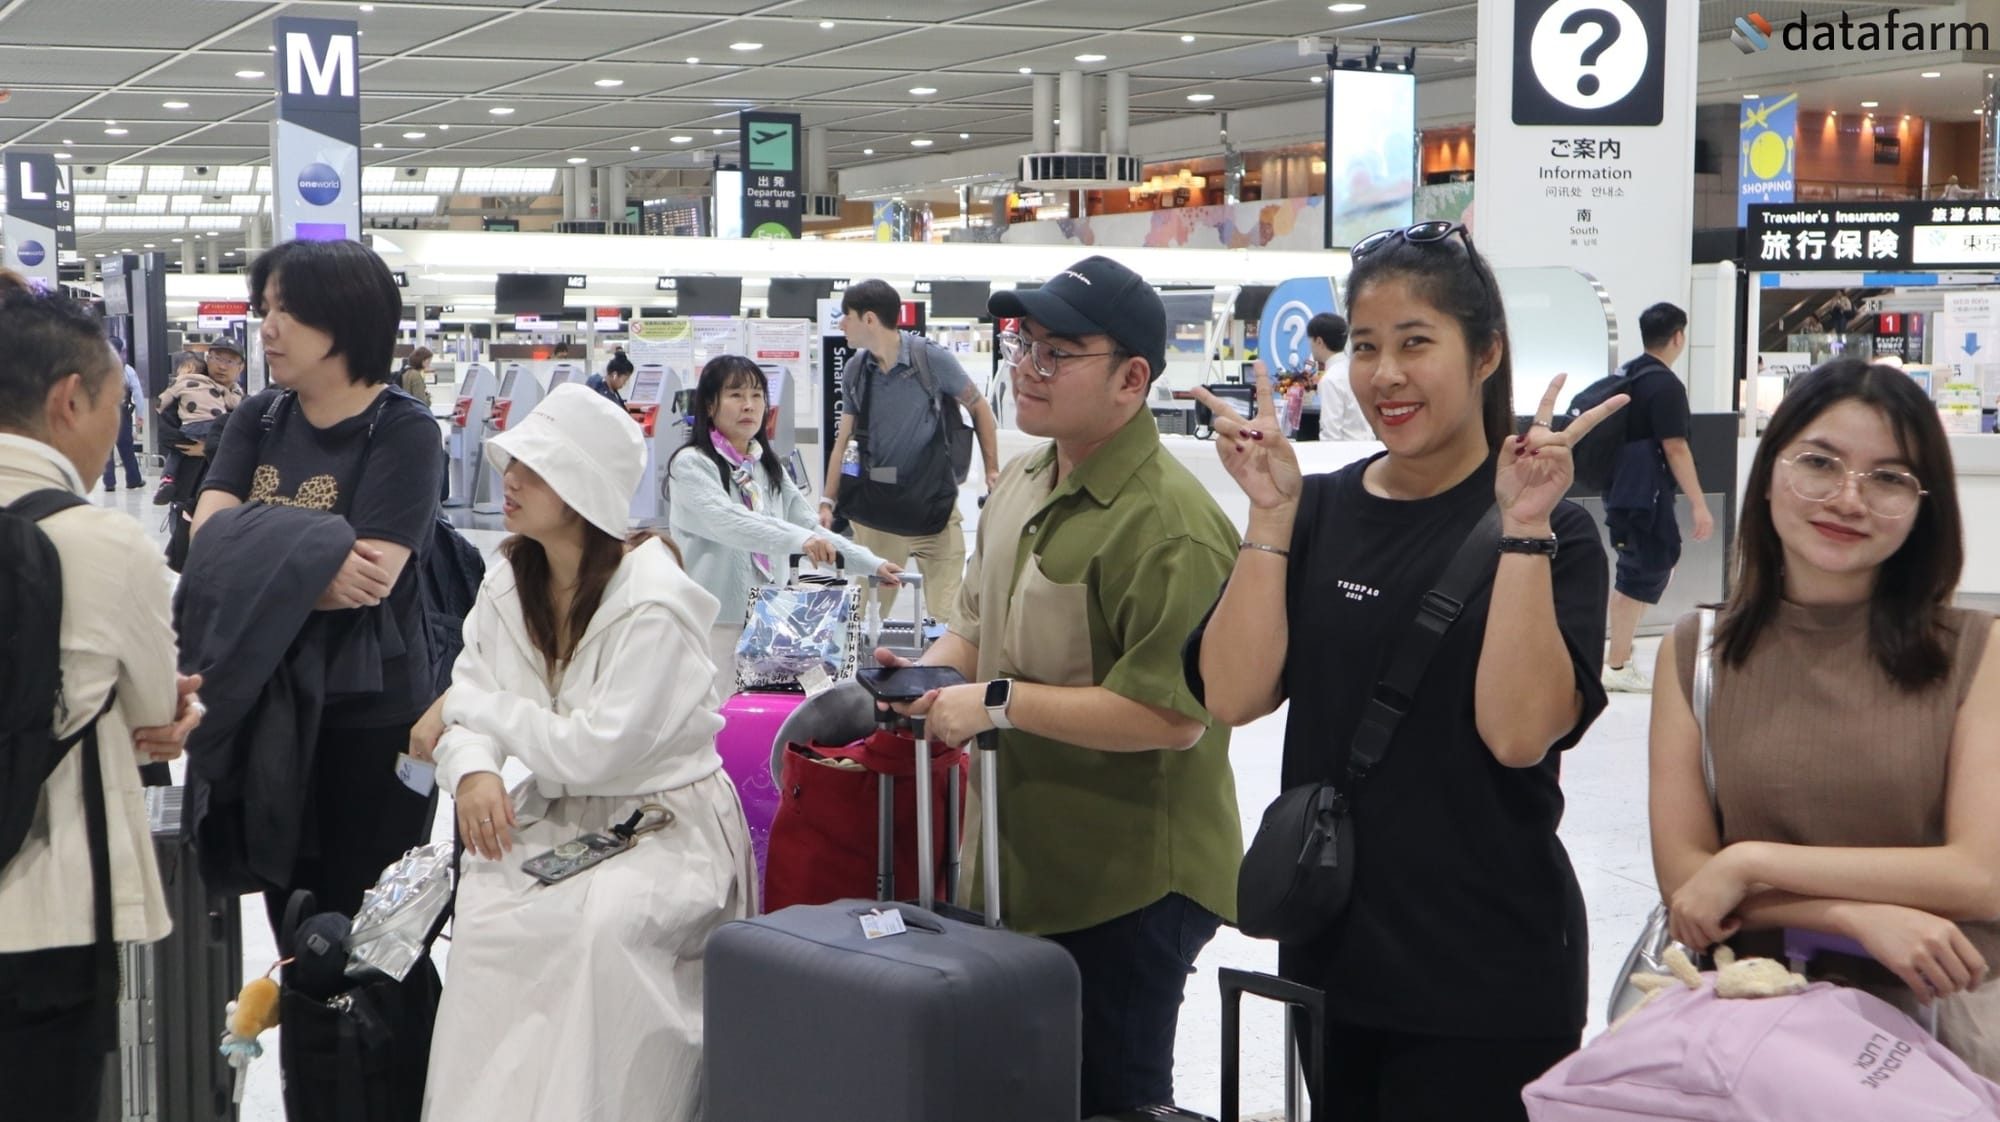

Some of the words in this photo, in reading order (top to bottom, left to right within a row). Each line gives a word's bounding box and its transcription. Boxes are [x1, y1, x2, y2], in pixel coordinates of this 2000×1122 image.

[286, 32, 354, 97] M
[1551, 138, 1621, 159] ご案内
[1539, 165, 1632, 180] Information
[20, 161, 48, 200] L
[299, 180, 340, 189] oneworld
[758, 176, 785, 188] 出発
[1742, 180, 1793, 195] SHOPPING
[747, 187, 796, 198] Departures
[1591, 185, 1625, 198] 안내소
[1576, 208, 1592, 222] 南
[1762, 209, 1829, 224] Traveller's
[1836, 210, 1900, 223] Insurance
[1569, 226, 1599, 236] South
[1760, 229, 1900, 260] 旅行保険
[568, 276, 584, 287] M2
[660, 278, 676, 289] M3
[1004, 318, 1015, 331] 2
[1885, 315, 1894, 332] 1
[833, 347, 846, 393] Smart
[1853, 1033, 1889, 1071] LUCK
